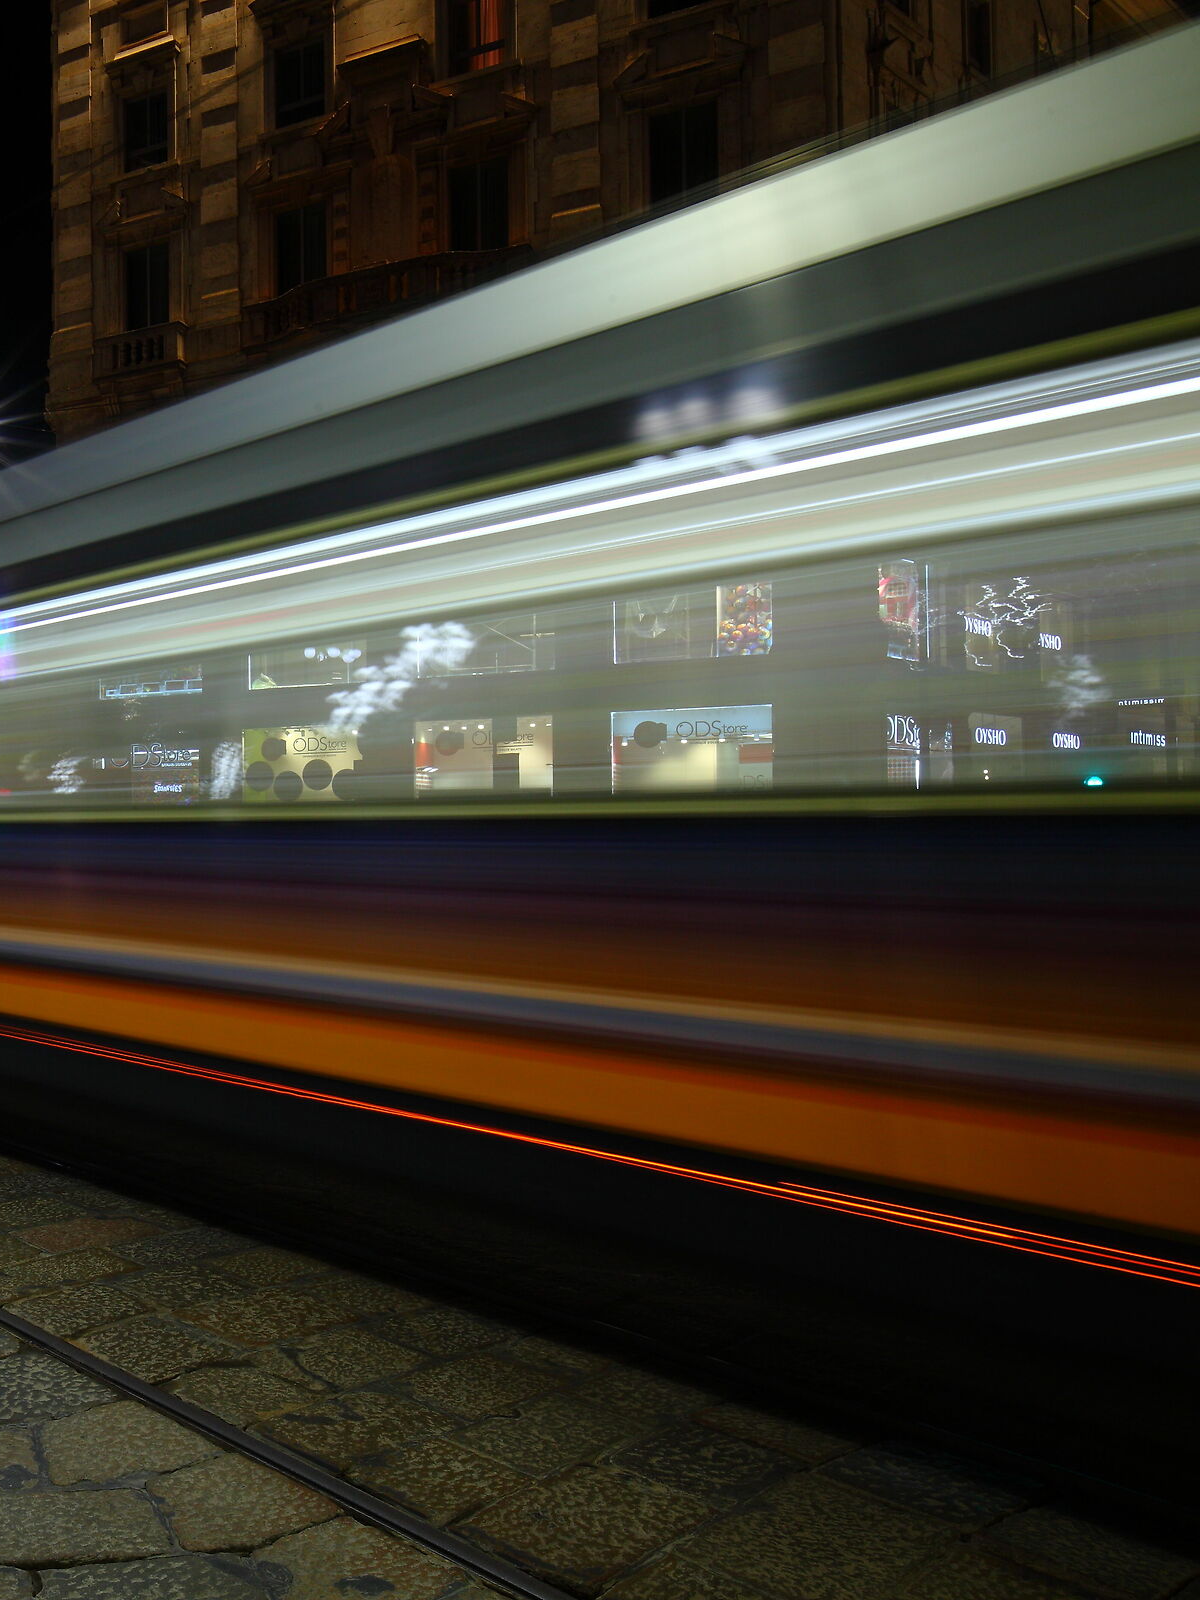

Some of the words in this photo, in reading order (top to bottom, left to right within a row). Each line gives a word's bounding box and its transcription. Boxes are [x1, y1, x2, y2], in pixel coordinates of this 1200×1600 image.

[1038, 633, 1062, 651] YSHO
[676, 720, 747, 738] ODStore
[975, 727, 1007, 746] OYSHO
[293, 736, 348, 752] ODStore
[1052, 732, 1081, 750] OYSHO
